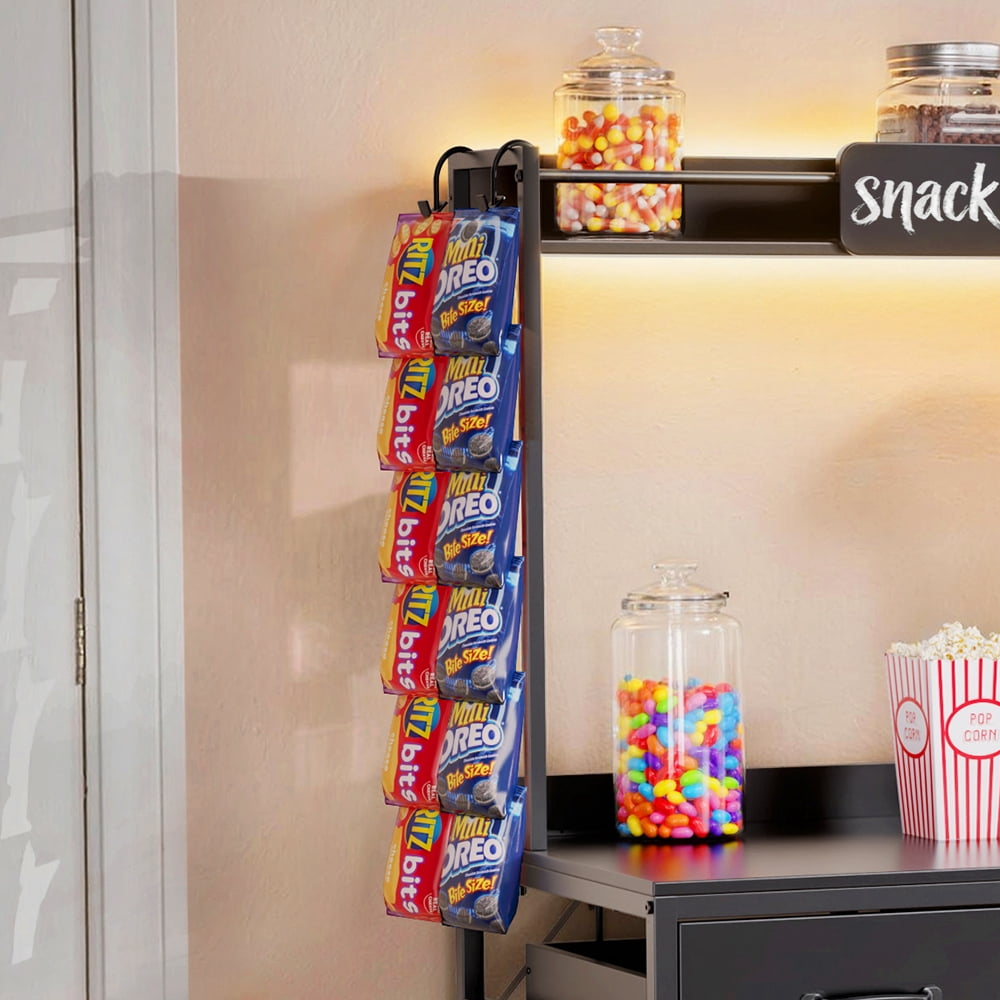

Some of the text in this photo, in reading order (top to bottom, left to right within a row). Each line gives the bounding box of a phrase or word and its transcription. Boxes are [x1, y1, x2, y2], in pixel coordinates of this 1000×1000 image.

[399, 238, 434, 286] RITZ
[443, 236, 485, 267] Mini
[392, 291, 416, 350] bits
[439, 296, 492, 330] Bite Size!
[400, 358, 434, 400] RITZ
[444, 356, 485, 383] Mini
[394, 405, 417, 464] bits
[441, 413, 493, 446] Bite Size!
[402, 472, 435, 514] RITZ
[447, 472, 487, 499] Mini
[396, 518, 419, 577] bits
[443, 529, 494, 562] Bite Size!
[404, 585, 437, 627] RITZ
[448, 587, 488, 614] Mini
[397, 631, 421, 690] bits
[445, 645, 496, 677] Bite Size!
[405, 697, 438, 740] RITZ
[450, 701, 490, 728] Mini
[970, 713, 993, 725] POP
[964, 729, 997, 742] CORN
[399, 744, 422, 802] bits
[446, 759, 496, 790] Bite Size!
[407, 809, 440, 851] RITZ
[451, 816, 491, 842] Mini
[401, 856, 423, 913] bits
[448, 881, 465, 904] Bite
[465, 875, 498, 894] Size!
